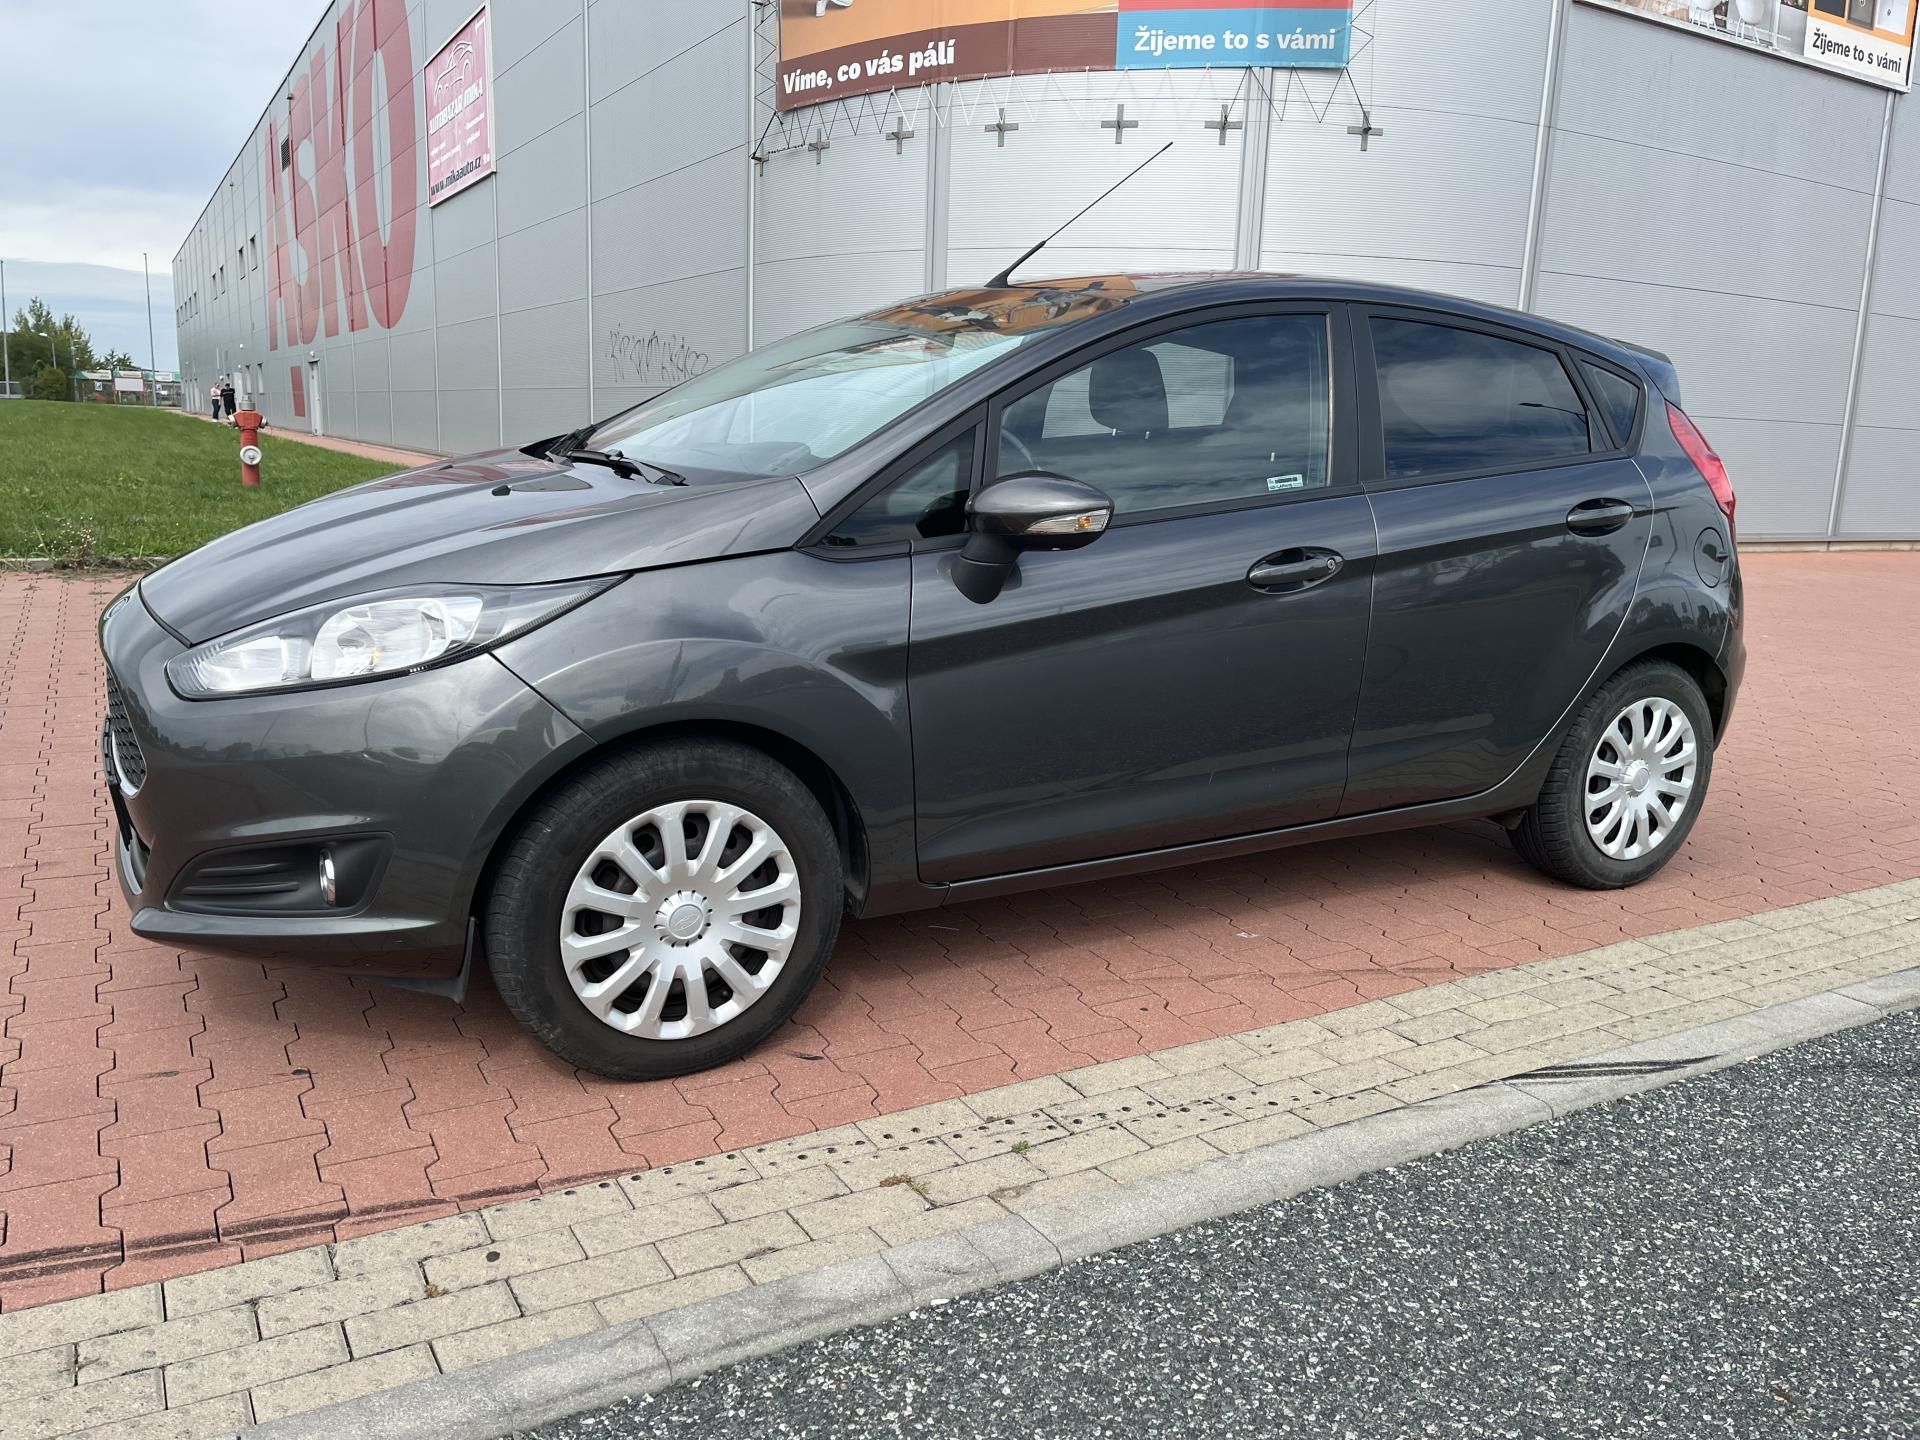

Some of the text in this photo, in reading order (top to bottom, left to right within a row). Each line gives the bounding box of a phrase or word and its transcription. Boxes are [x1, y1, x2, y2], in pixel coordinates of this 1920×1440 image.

[1134, 25, 1336, 57] Žijeme to s vámi
[1812, 27, 1902, 74] Žijeme to s vámi
[783, 39, 957, 94] Víme, co vás pálí
[266, 0, 416, 352] ASKO
[430, 156, 481, 196] www.mikaauto.cz
